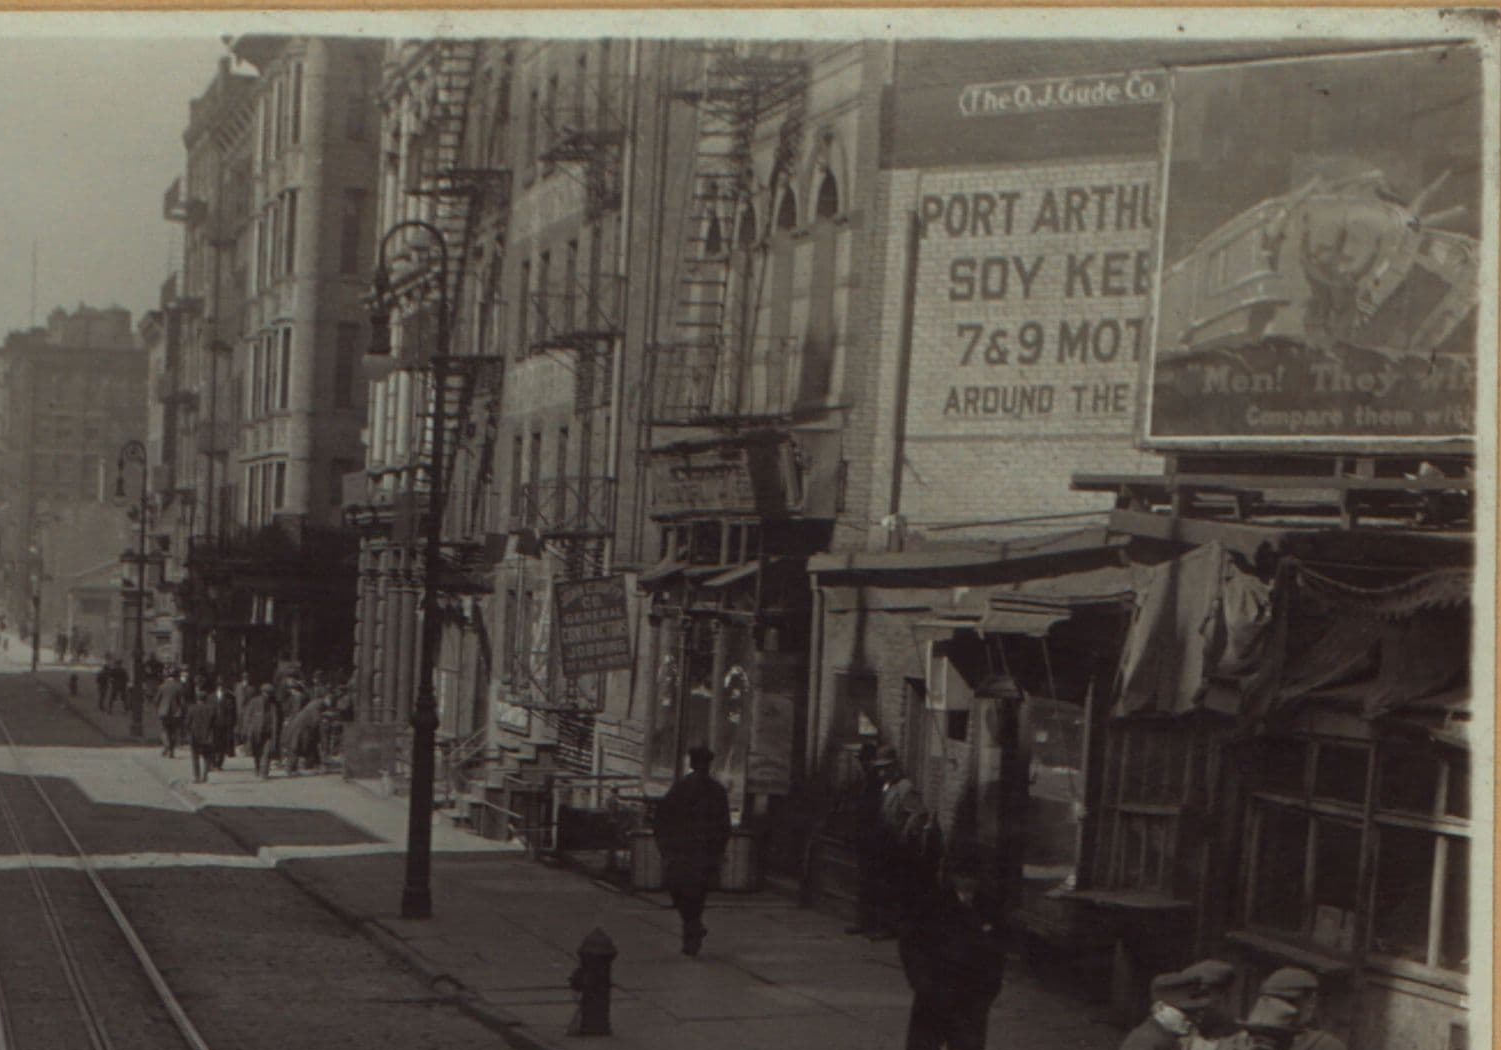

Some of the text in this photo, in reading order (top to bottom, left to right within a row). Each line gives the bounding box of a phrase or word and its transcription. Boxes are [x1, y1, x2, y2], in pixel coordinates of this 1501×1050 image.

[968, 89, 1011, 112] The
[1058, 79, 1121, 106] Gude
[921, 192, 1021, 238] PORT
[950, 256, 1045, 300] SOY
[1310, 362, 1398, 398] They
[943, 382, 1132, 418] AROUND THE
[1246, 404, 1344, 431] Compare
[1354, 404, 1414, 425] them
